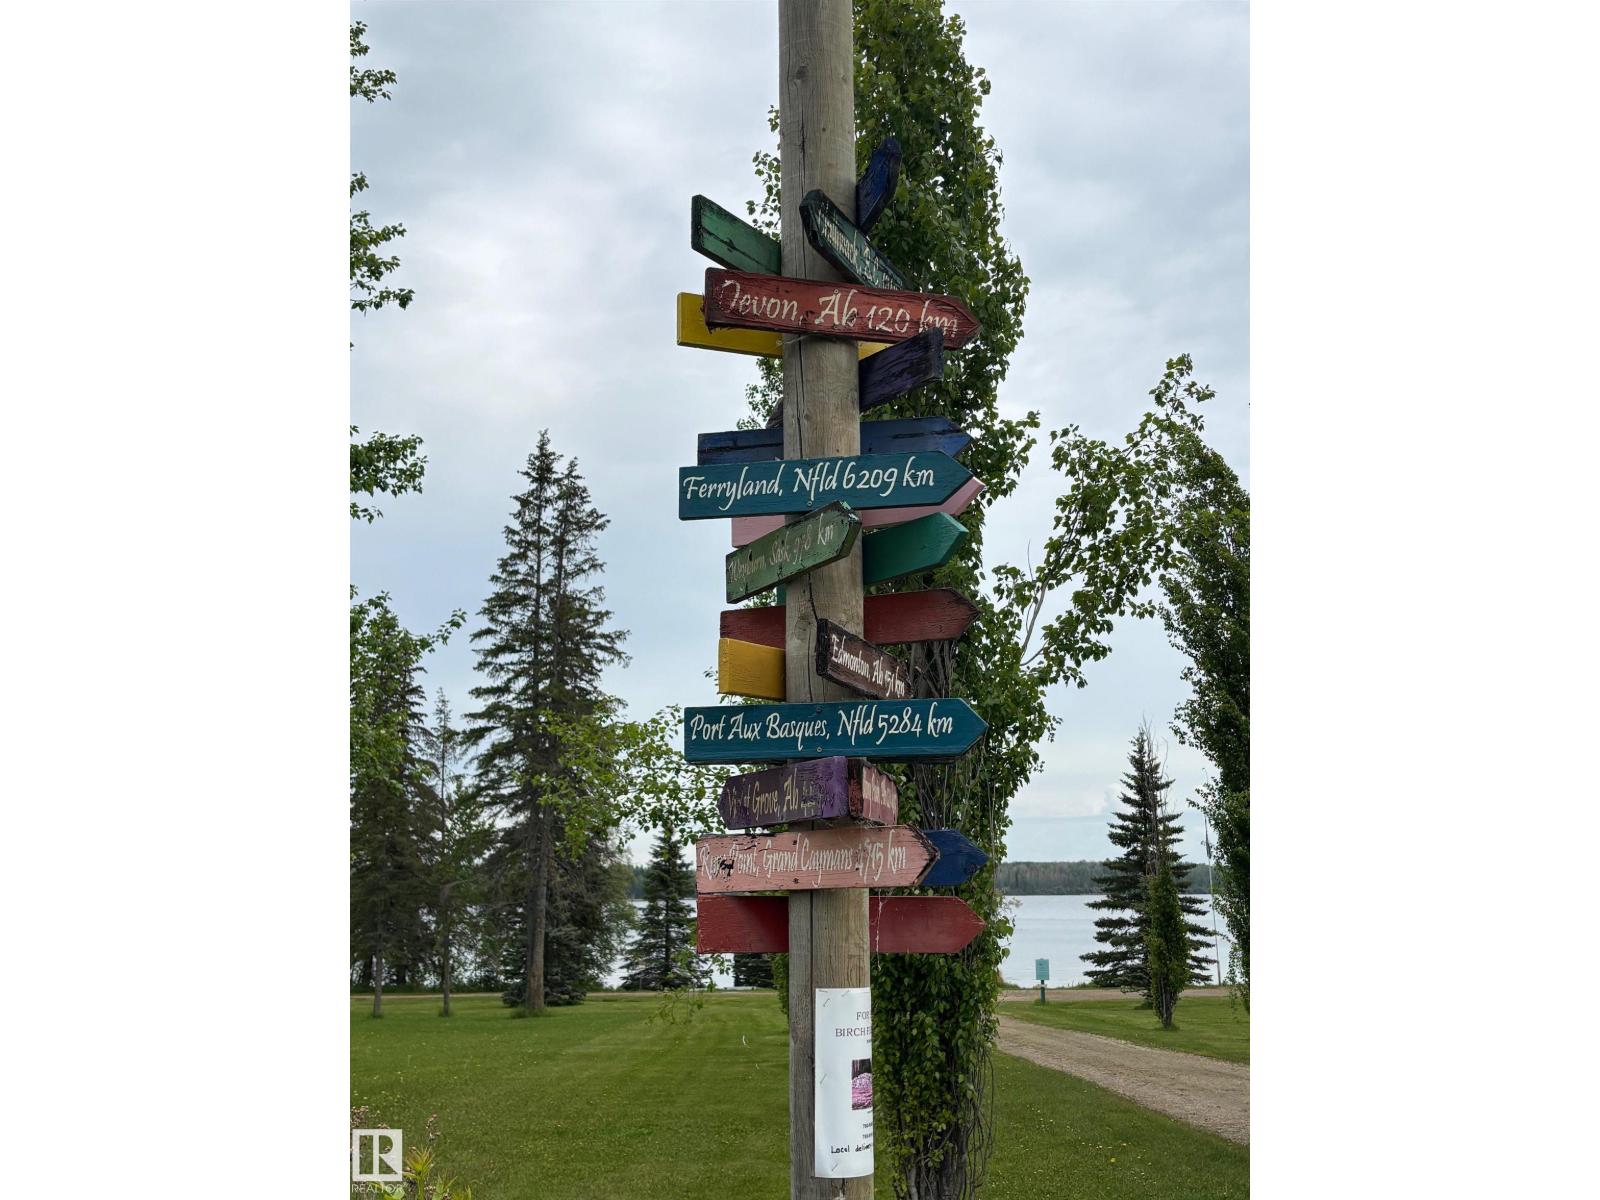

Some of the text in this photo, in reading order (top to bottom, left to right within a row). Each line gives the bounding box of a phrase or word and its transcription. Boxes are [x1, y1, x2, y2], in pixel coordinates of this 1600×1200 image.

[815, 289, 858, 327] Ab
[866, 304, 909, 334] 120
[919, 299, 958, 338] km
[683, 455, 935, 512] Ferryland, Nfld 6209 km
[817, 512, 834, 546] km
[831, 633, 871, 682] Edmonton,
[871, 655, 883, 687] Ab
[894, 665, 905, 699] km
[690, 701, 953, 751] Port Aux Basques, Nfld 5284 km
[752, 780, 781, 822] Grove,
[783, 766, 798, 813] Ab
[762, 832, 801, 878] Grand
[801, 837, 853, 888] Caymans
[887, 829, 906, 875] km
[831, 1144, 850, 1154] Local
